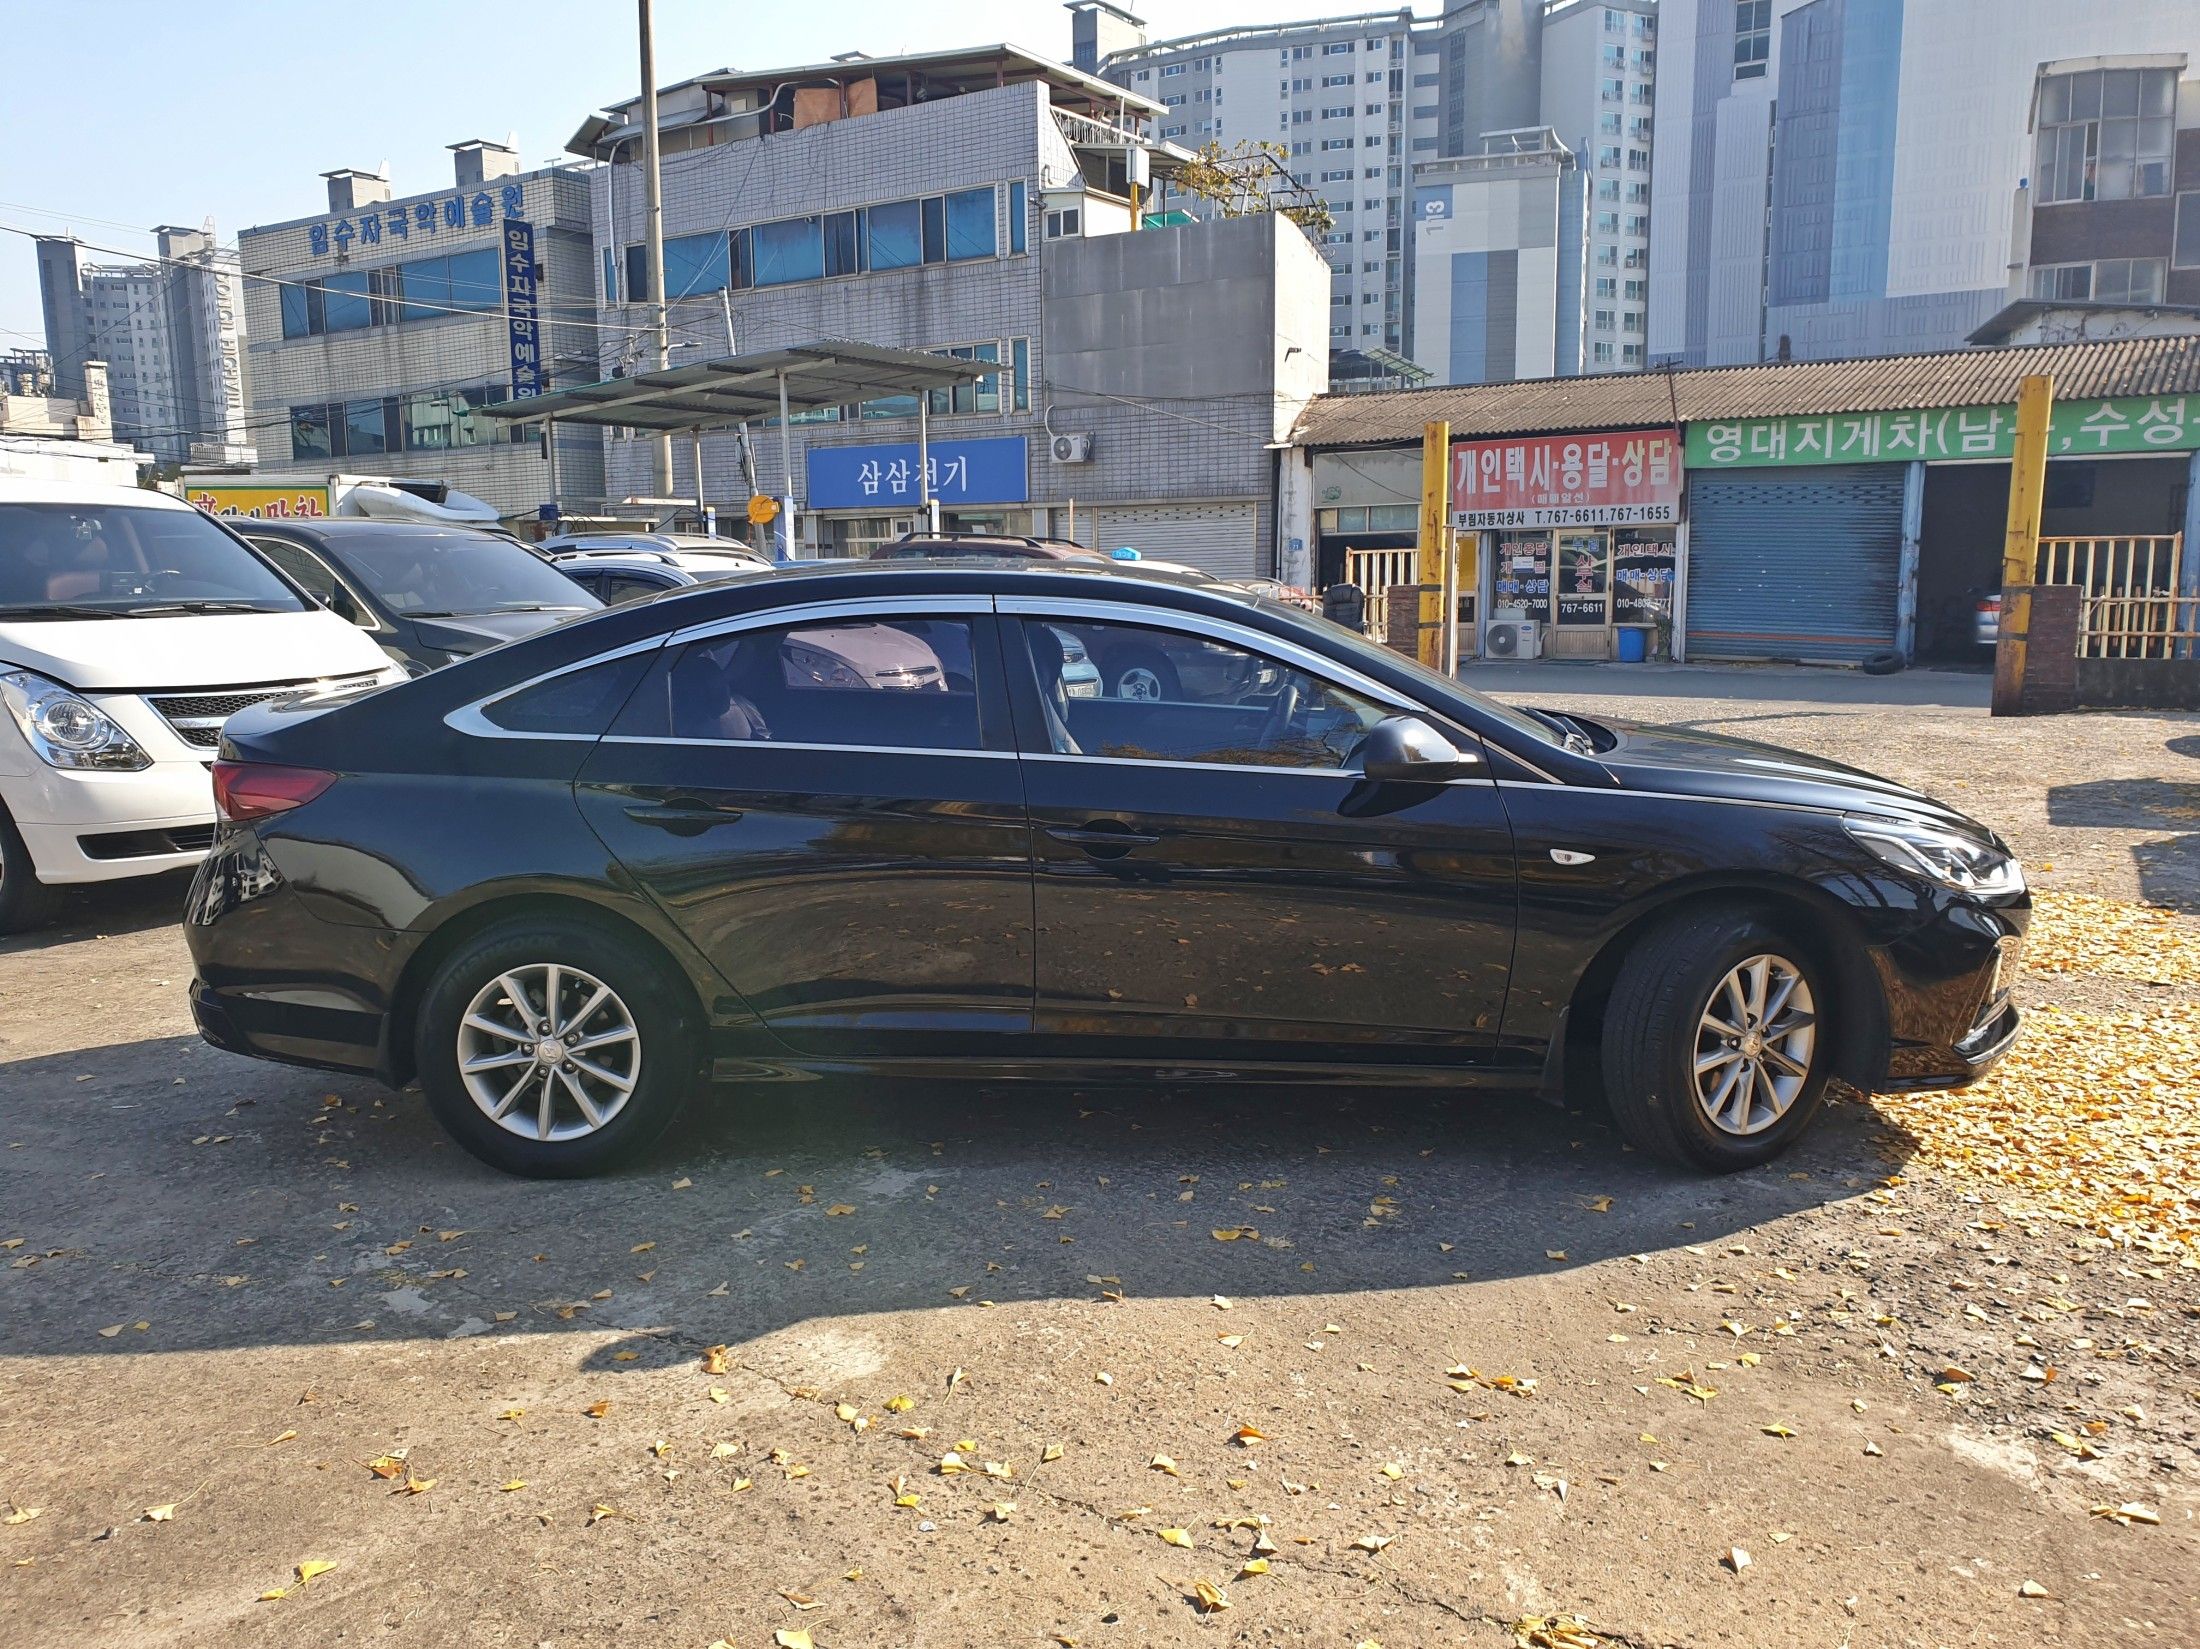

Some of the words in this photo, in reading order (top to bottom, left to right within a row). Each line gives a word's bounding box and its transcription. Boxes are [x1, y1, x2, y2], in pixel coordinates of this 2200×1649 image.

[309, 184, 525, 256] 임수자국악예술원
[857, 455, 967, 496] 삼삼전기
[1458, 510, 1526, 527] 부림자동차상사
[1500, 542, 1548, 556] 개인용달
[1617, 542, 1673, 557] 개인택시
[1560, 602, 1603, 613] 767-6611
